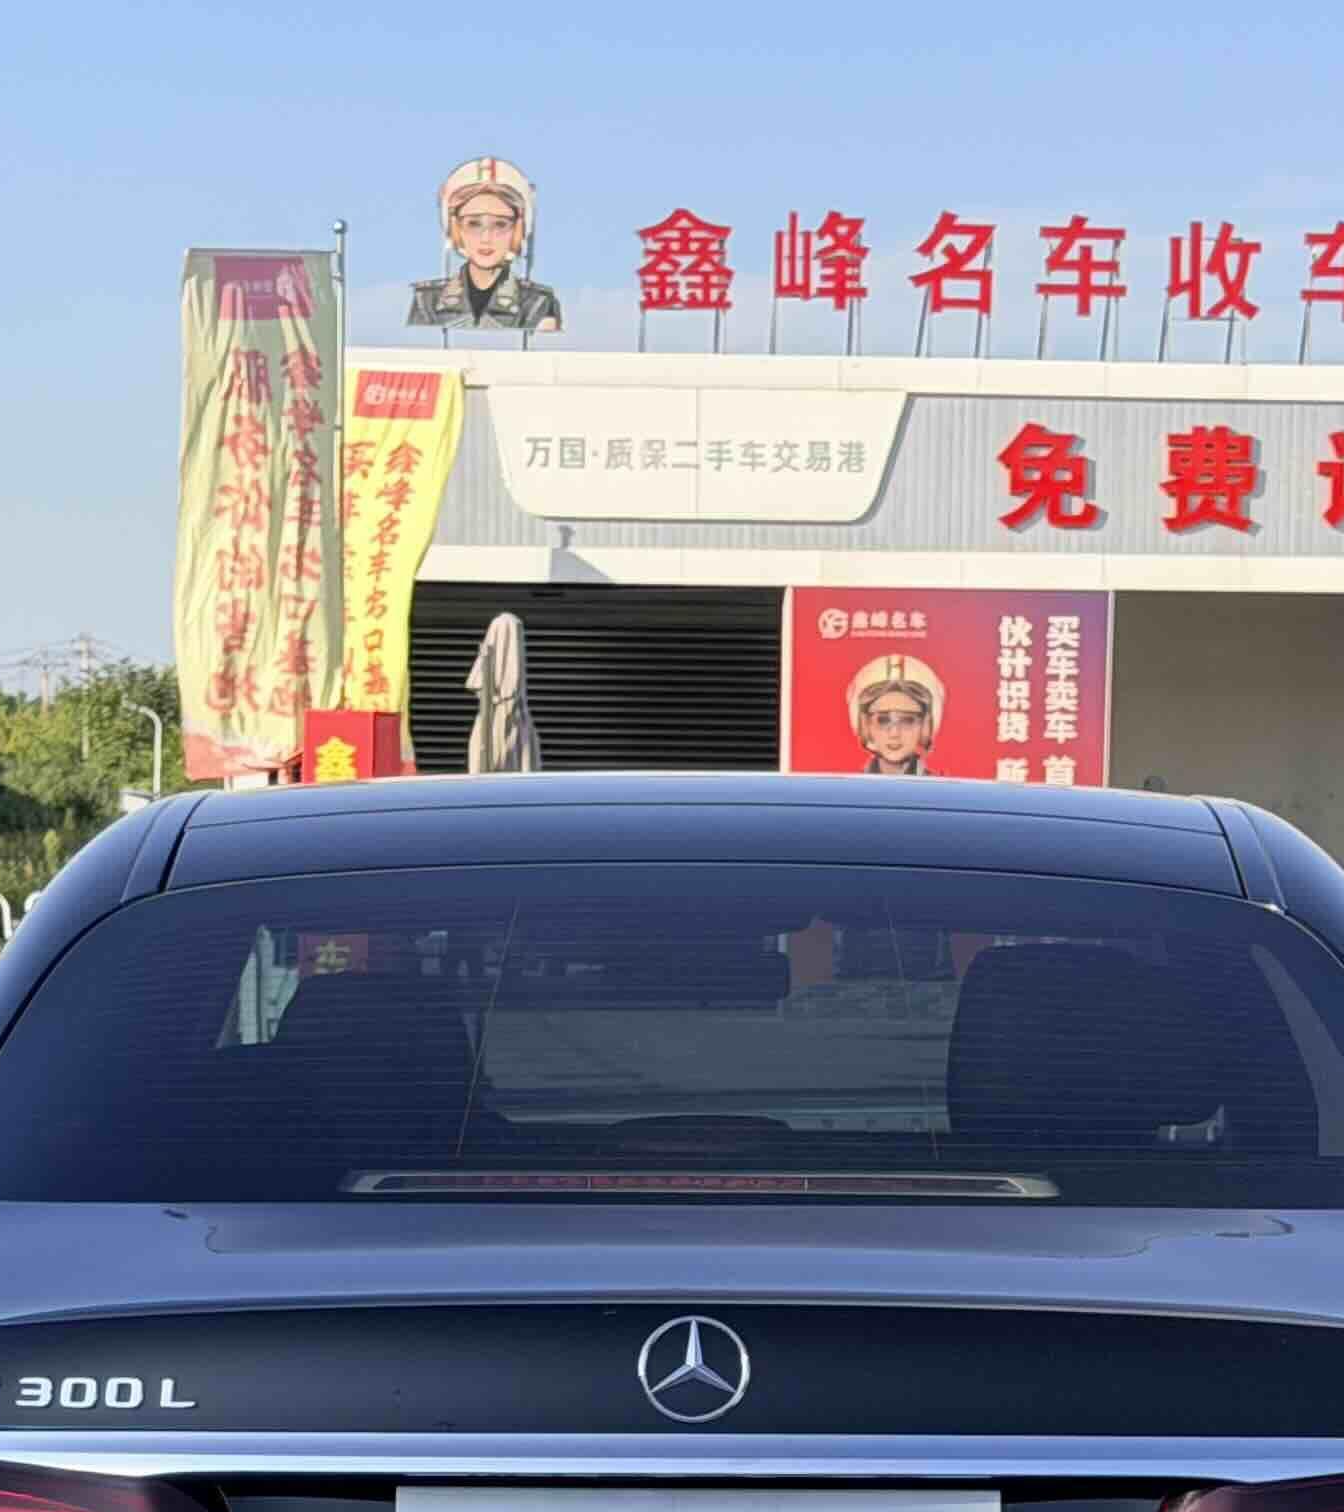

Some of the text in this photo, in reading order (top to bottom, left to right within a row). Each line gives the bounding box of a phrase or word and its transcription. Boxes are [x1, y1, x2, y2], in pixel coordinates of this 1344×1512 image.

[1044, 616, 1080, 744] 买车卖车
[314, 736, 358, 783] 鑫
[15, 1376, 144, 1409] 300
[159, 1377, 197, 1409] L
